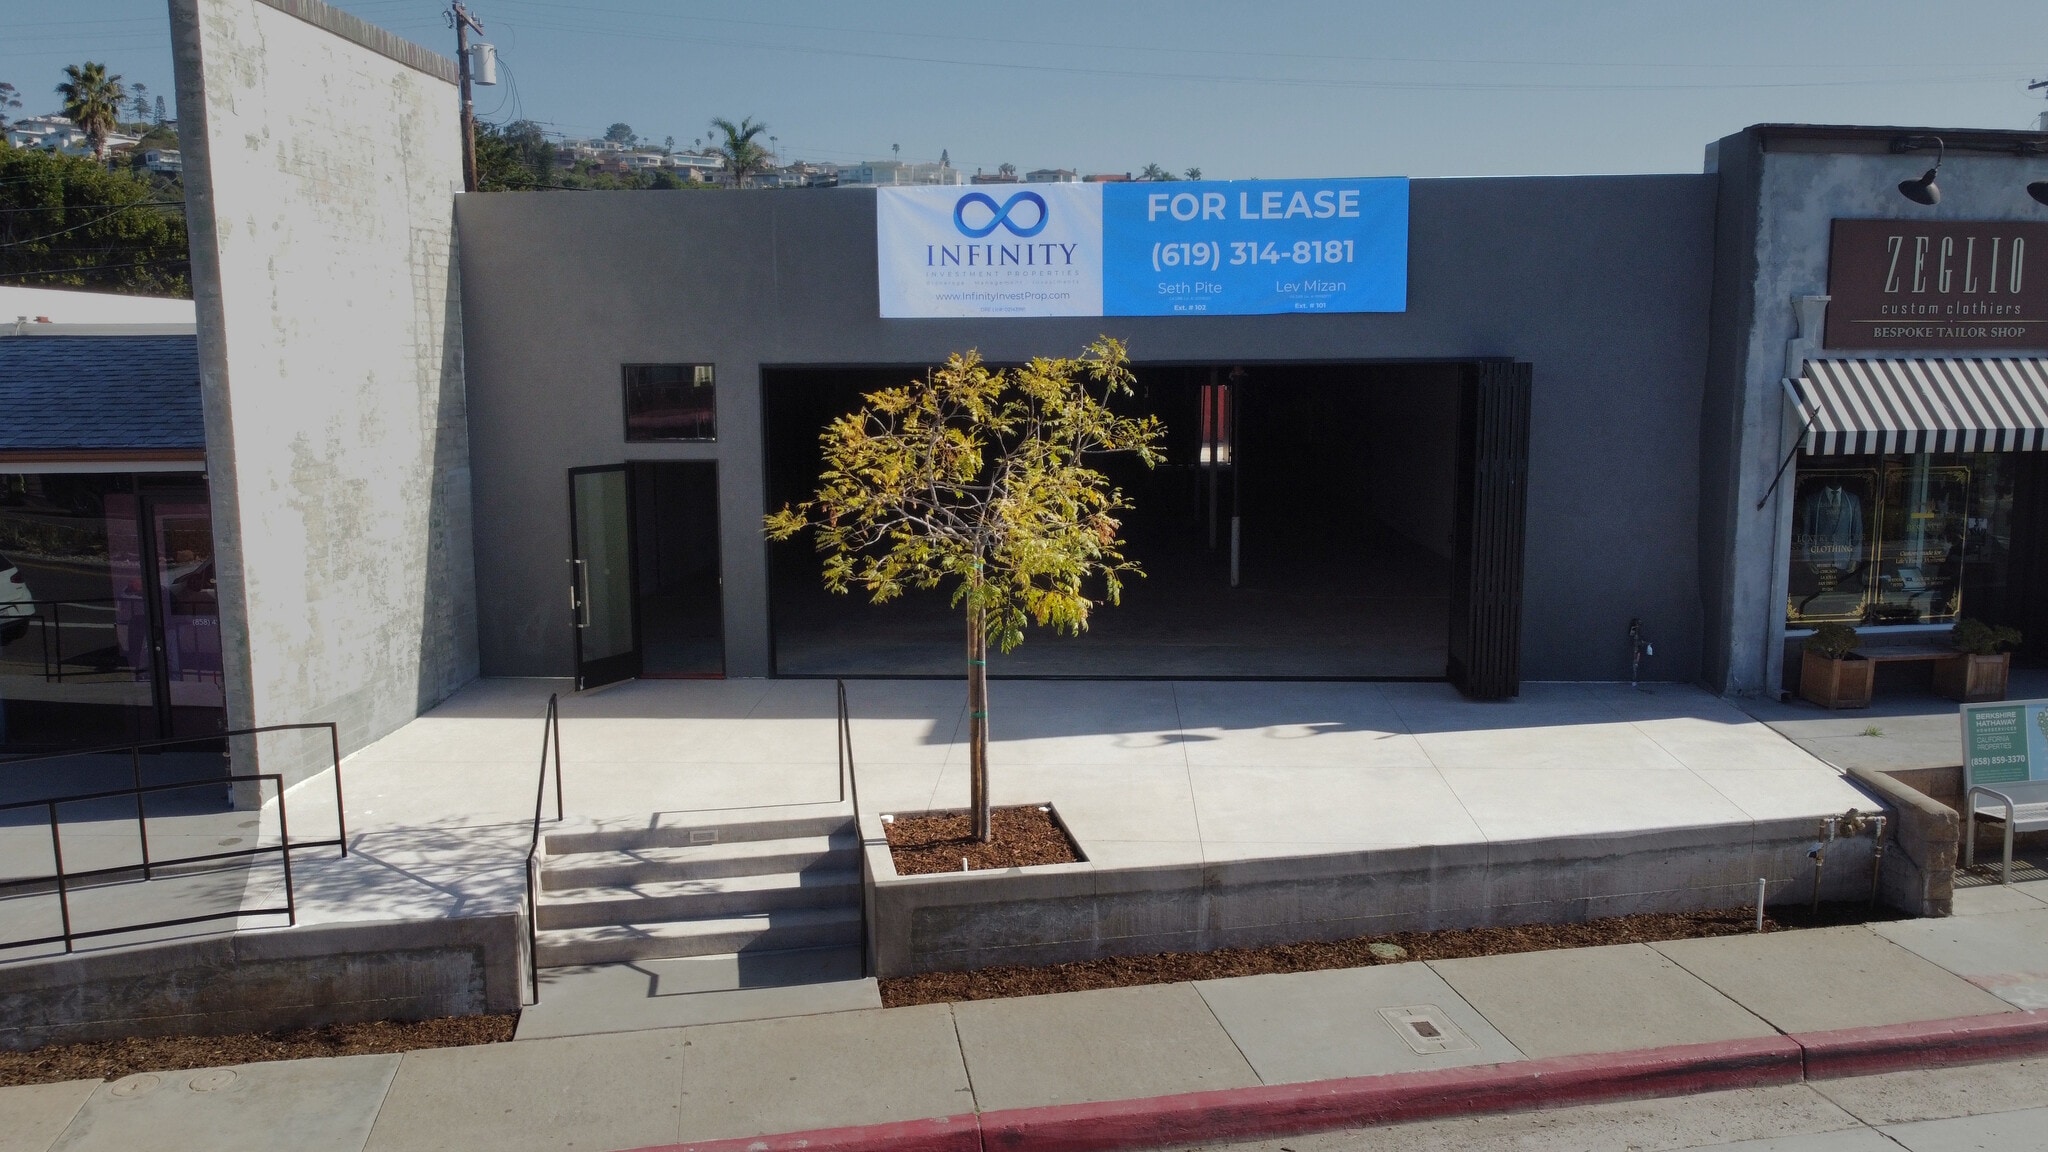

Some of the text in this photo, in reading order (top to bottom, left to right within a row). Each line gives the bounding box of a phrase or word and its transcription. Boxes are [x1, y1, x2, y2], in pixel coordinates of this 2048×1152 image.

[1148, 190, 1360, 222] FOR LEASE
[926, 243, 1078, 267] INFINITY
[1152, 239, 1354, 272] (619) 314-8181
[1884, 236, 2025, 294] ZEGLIO
[926, 269, 1080, 278] INVESTMENT PROPERTIES
[1158, 281, 1223, 295] Seth Pite
[1276, 279, 1346, 293] Lev Mizan
[935, 291, 1070, 303] www.InfinityInvestProp.com
[1881, 301, 2022, 315] custom clothiers
[1873, 327, 2026, 338] BESPOKE TAILOR SHOP
[1810, 545, 1853, 554] CLOTHING
[1975, 711, 2017, 720] BERKSHIRE
[1976, 719, 2016, 727] HATHAWAY
[1977, 742, 2012, 750] PROPERTIES
[1971, 755, 2026, 767] (858) 859-3370
